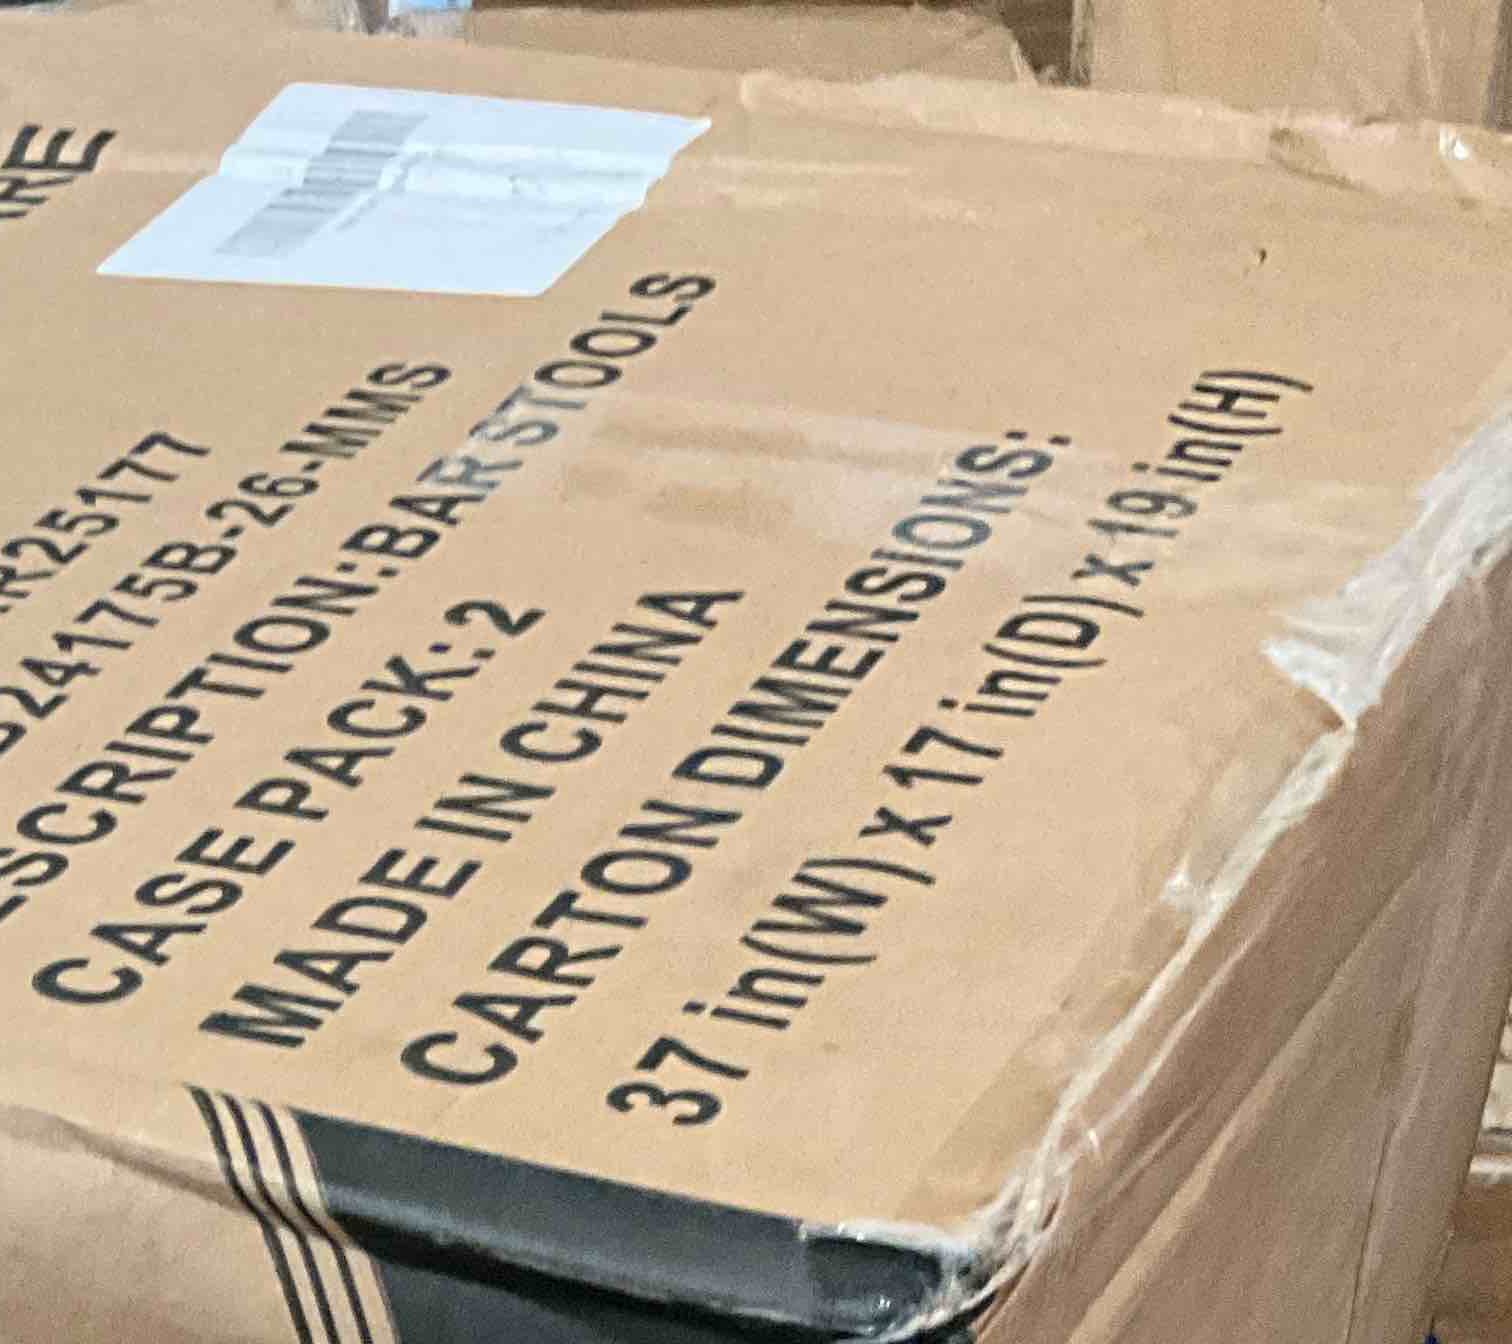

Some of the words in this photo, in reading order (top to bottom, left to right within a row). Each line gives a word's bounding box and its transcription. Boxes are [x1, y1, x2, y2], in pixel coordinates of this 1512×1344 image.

[1132, 370, 1314, 482] in(H)
[1070, 553, 1155, 587] x
[1086, 490, 1198, 539] 19
[938, 594, 1145, 717] in(D)
[31, 829, 296, 1006] CASE
[234, 598, 546, 822] PACK:2
[399, 799, 744, 1086] CARTON
[672, 430, 1071, 790] DIMENSIONS:
[883, 726, 1004, 789] 17
[199, 848, 482, 1048] MADE
[415, 774, 555, 842] IN
[499, 589, 746, 766] CHINA
[859, 806, 954, 847] x
[683, 857, 936, 1030] in(W)
[606, 1037, 750, 1128] 37
